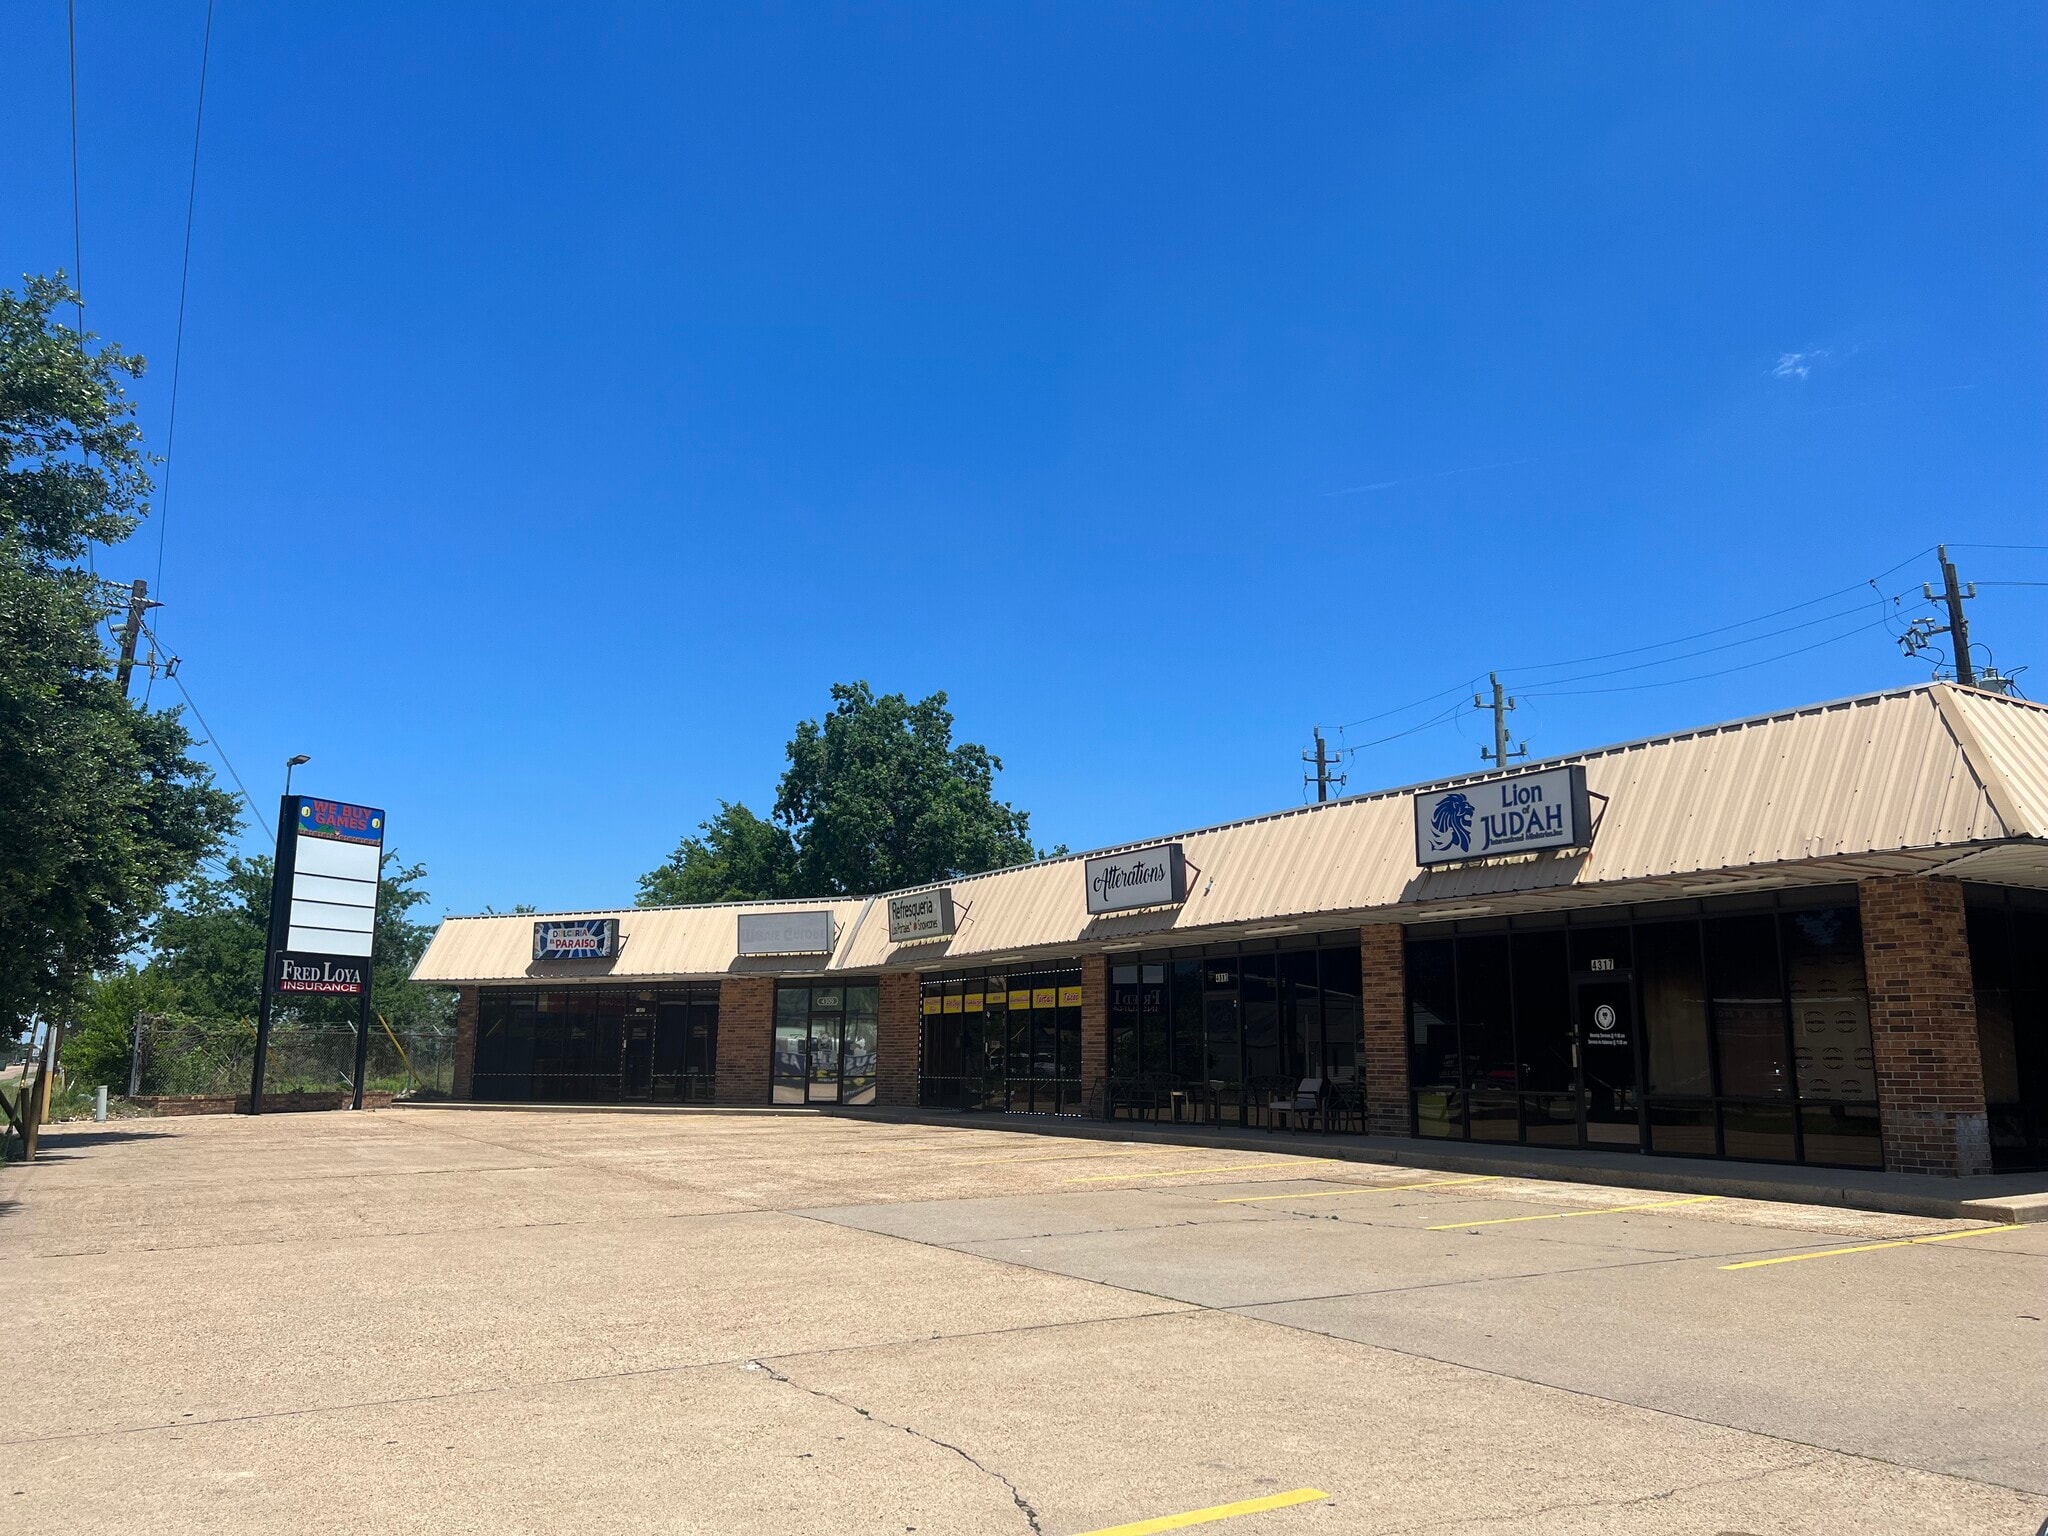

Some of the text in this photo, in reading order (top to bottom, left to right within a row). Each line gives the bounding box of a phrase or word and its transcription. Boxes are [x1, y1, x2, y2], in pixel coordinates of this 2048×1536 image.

[1501, 783, 1543, 808] Lion
[313, 800, 372, 819] WE BUY
[1521, 804, 1531, 815] of
[314, 813, 367, 831] GAMES
[1480, 804, 1563, 851] JUDAH
[1093, 861, 1166, 902] Alterations
[555, 939, 596, 949] PARAISO
[280, 959, 362, 983] FRED LOYA
[1592, 959, 1614, 971] 4317
[283, 981, 358, 992] INSURANCE
